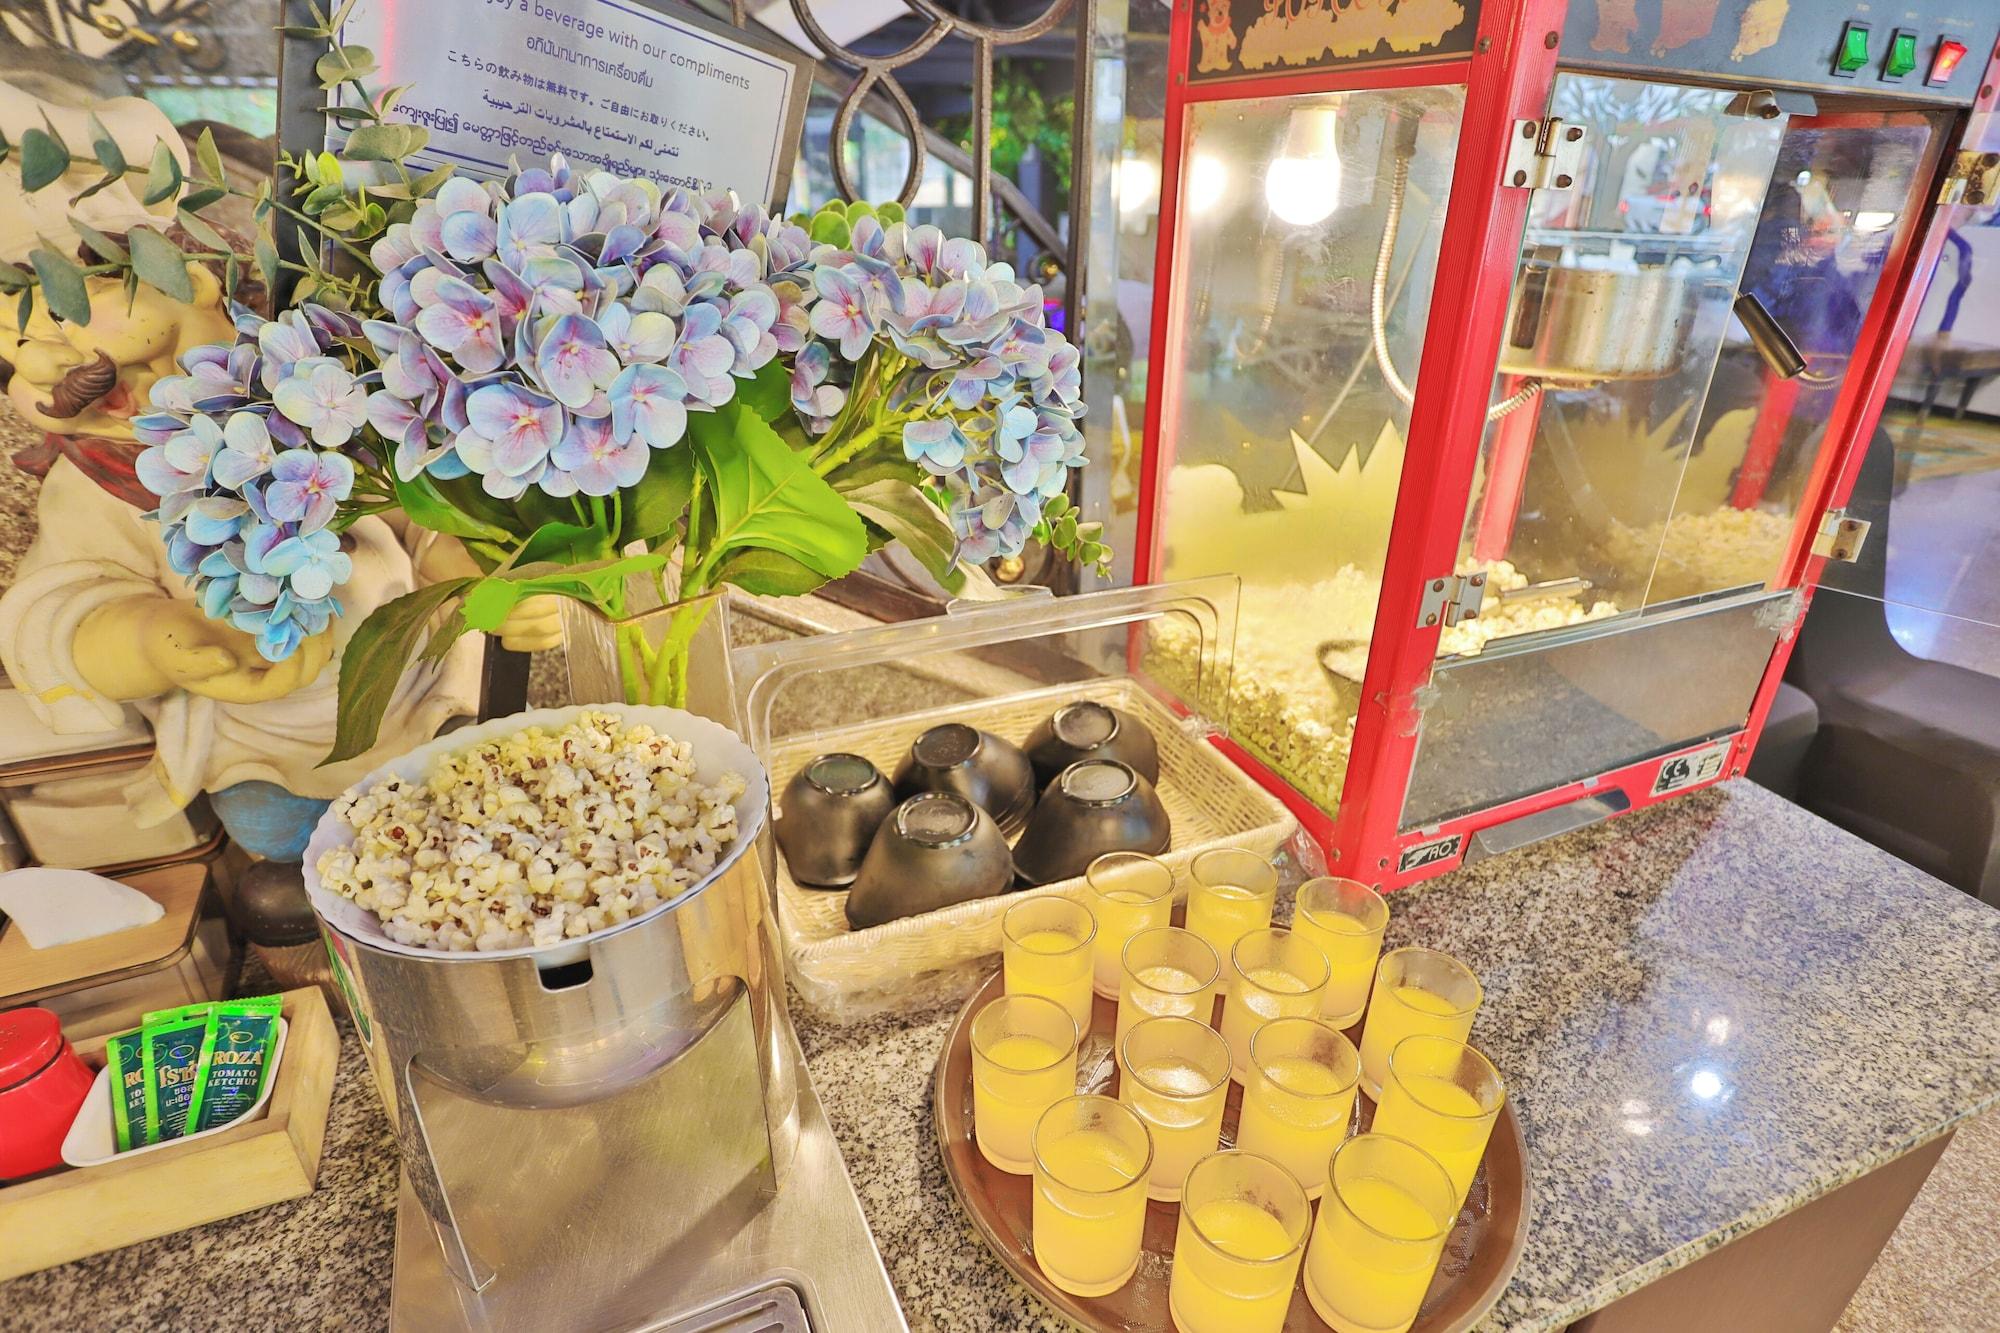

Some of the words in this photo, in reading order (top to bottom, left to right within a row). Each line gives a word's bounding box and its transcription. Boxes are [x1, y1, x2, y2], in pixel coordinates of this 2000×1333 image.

[534, 0, 605, 39] beverage
[609, 30, 638, 51] with
[643, 42, 667, 61] our
[670, 52, 751, 91] compliments
[526, 35, 654, 89] อภินันทนาการเครื่องดื่ม
[594, 125, 637, 145] الاستمتاع
[638, 140, 653, 152] لكم
[654, 144, 680, 157] نتمنى
[212, 1050, 263, 1066] ROZA
[212, 1069, 258, 1079] TOMATO
[207, 1078, 259, 1088] KETCHUP
